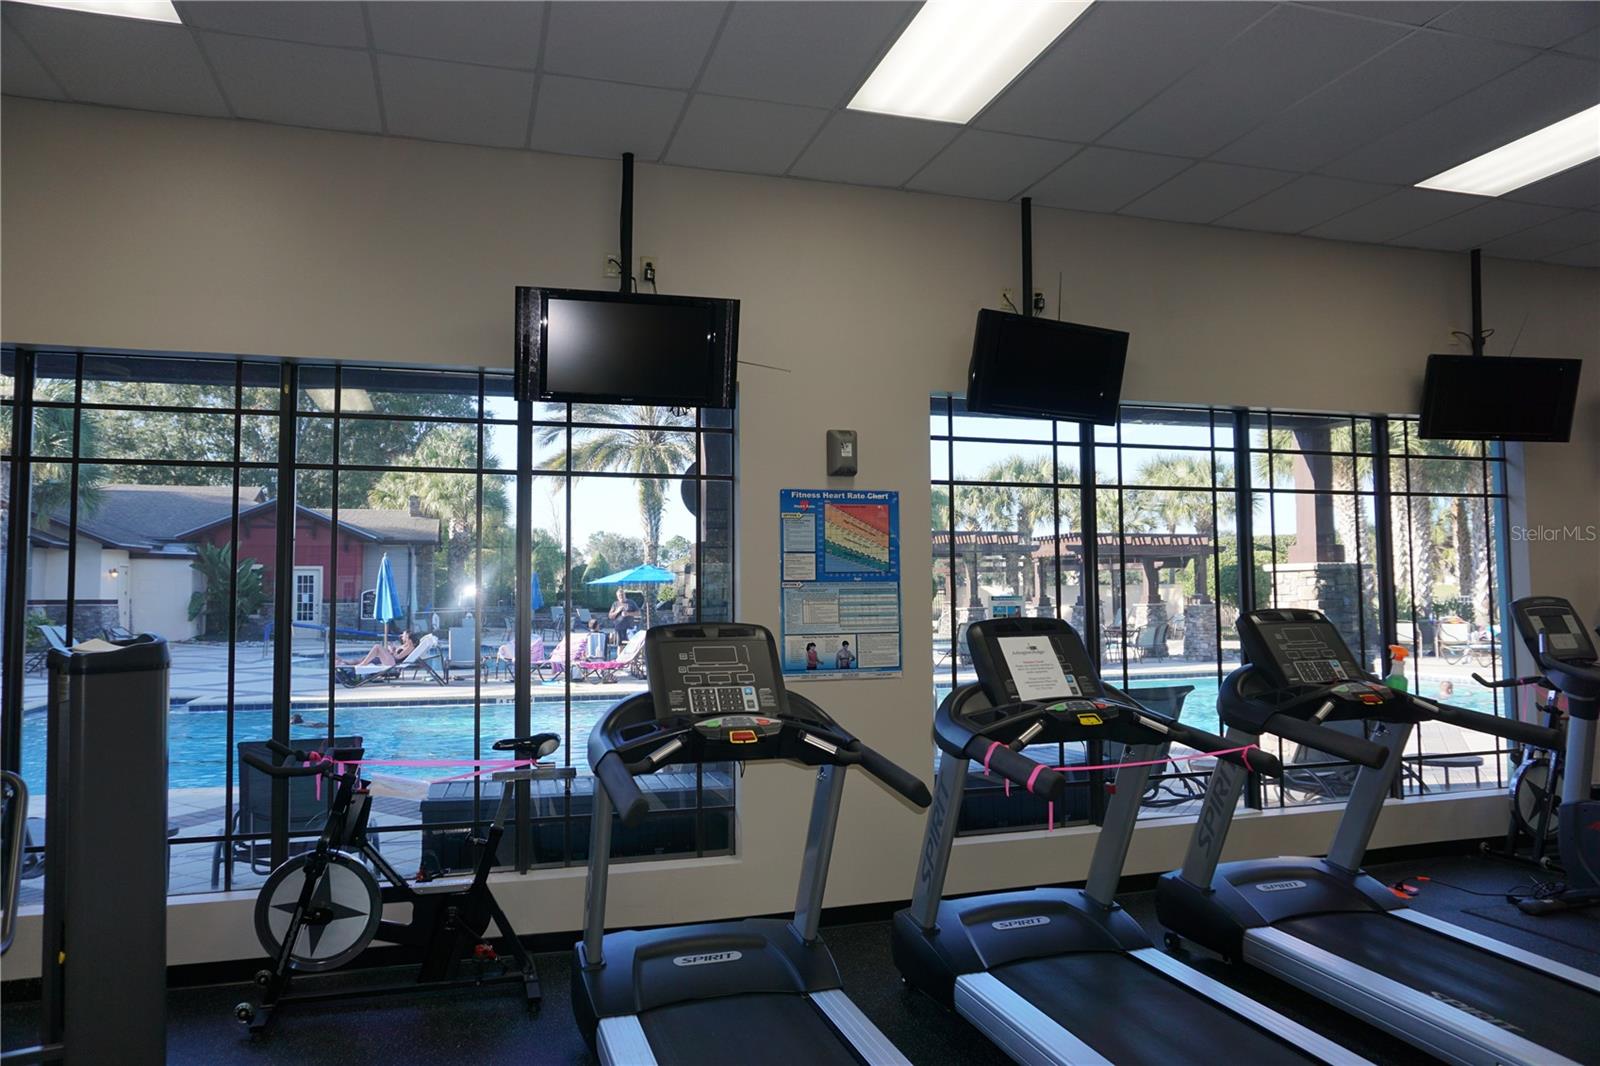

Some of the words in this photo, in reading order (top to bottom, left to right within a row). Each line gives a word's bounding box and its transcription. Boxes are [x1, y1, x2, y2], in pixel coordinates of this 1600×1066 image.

[792, 491, 821, 499] Fitness
[867, 492, 889, 500] Chart
[921, 783, 949, 891] SPIRIT
[999, 917, 1042, 928] SPIRIT
[681, 952, 734, 964] SPIRIT
